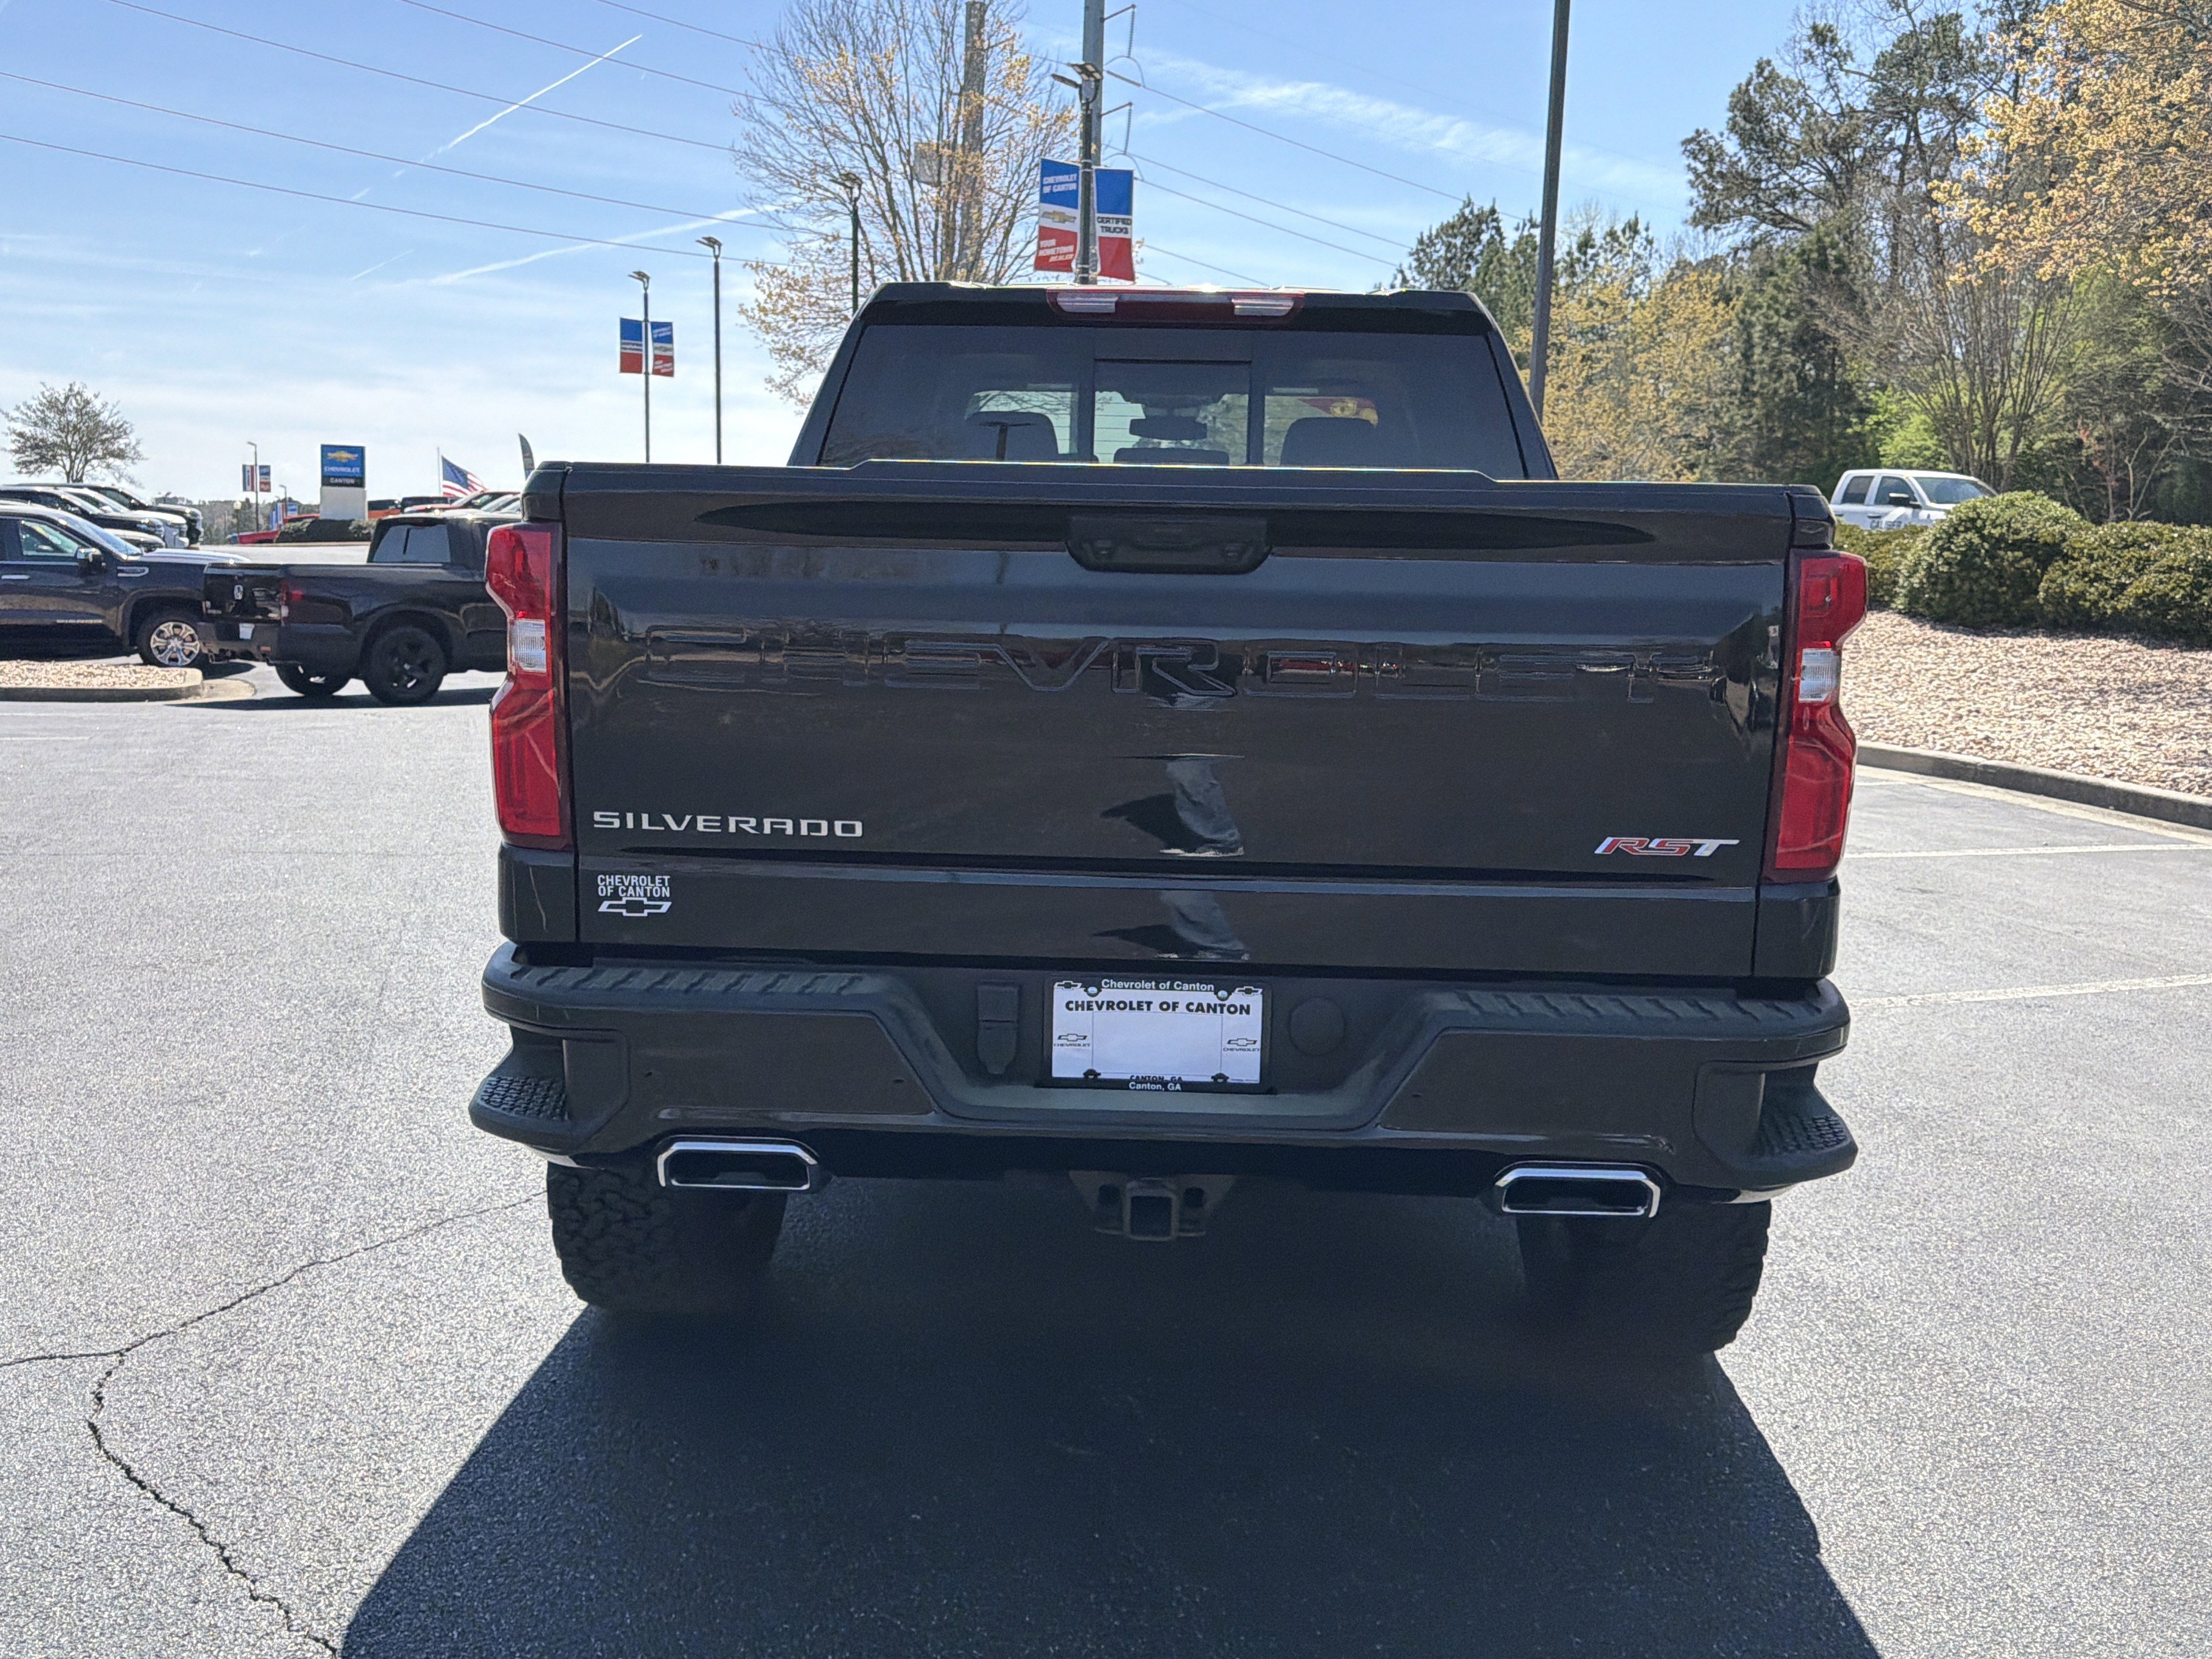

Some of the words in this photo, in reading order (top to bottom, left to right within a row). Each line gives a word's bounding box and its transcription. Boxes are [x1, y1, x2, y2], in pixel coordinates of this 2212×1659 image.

[1043, 185, 1052, 194] OF
[1097, 216, 1132, 225] CERTIFIED
[1100, 225, 1128, 235] TRUCKS
[593, 811, 863, 837] SILVERADO
[1594, 837, 1740, 857] RST
[597, 874, 670, 887] CHEVROLET
[598, 885, 614, 896] OF
[618, 885, 670, 898] CANTON
[1101, 979, 1156, 990] Chevrolet
[1159, 981, 1171, 990] of
[1173, 981, 1215, 991] Canton
[1065, 1000, 1153, 1012] CHEVROLET
[1159, 1001, 1180, 1012] OF
[1185, 1002, 1251, 1015] CANTON
[1128, 1081, 1165, 1091] Canton,
[1167, 1082, 1182, 1091] GA
